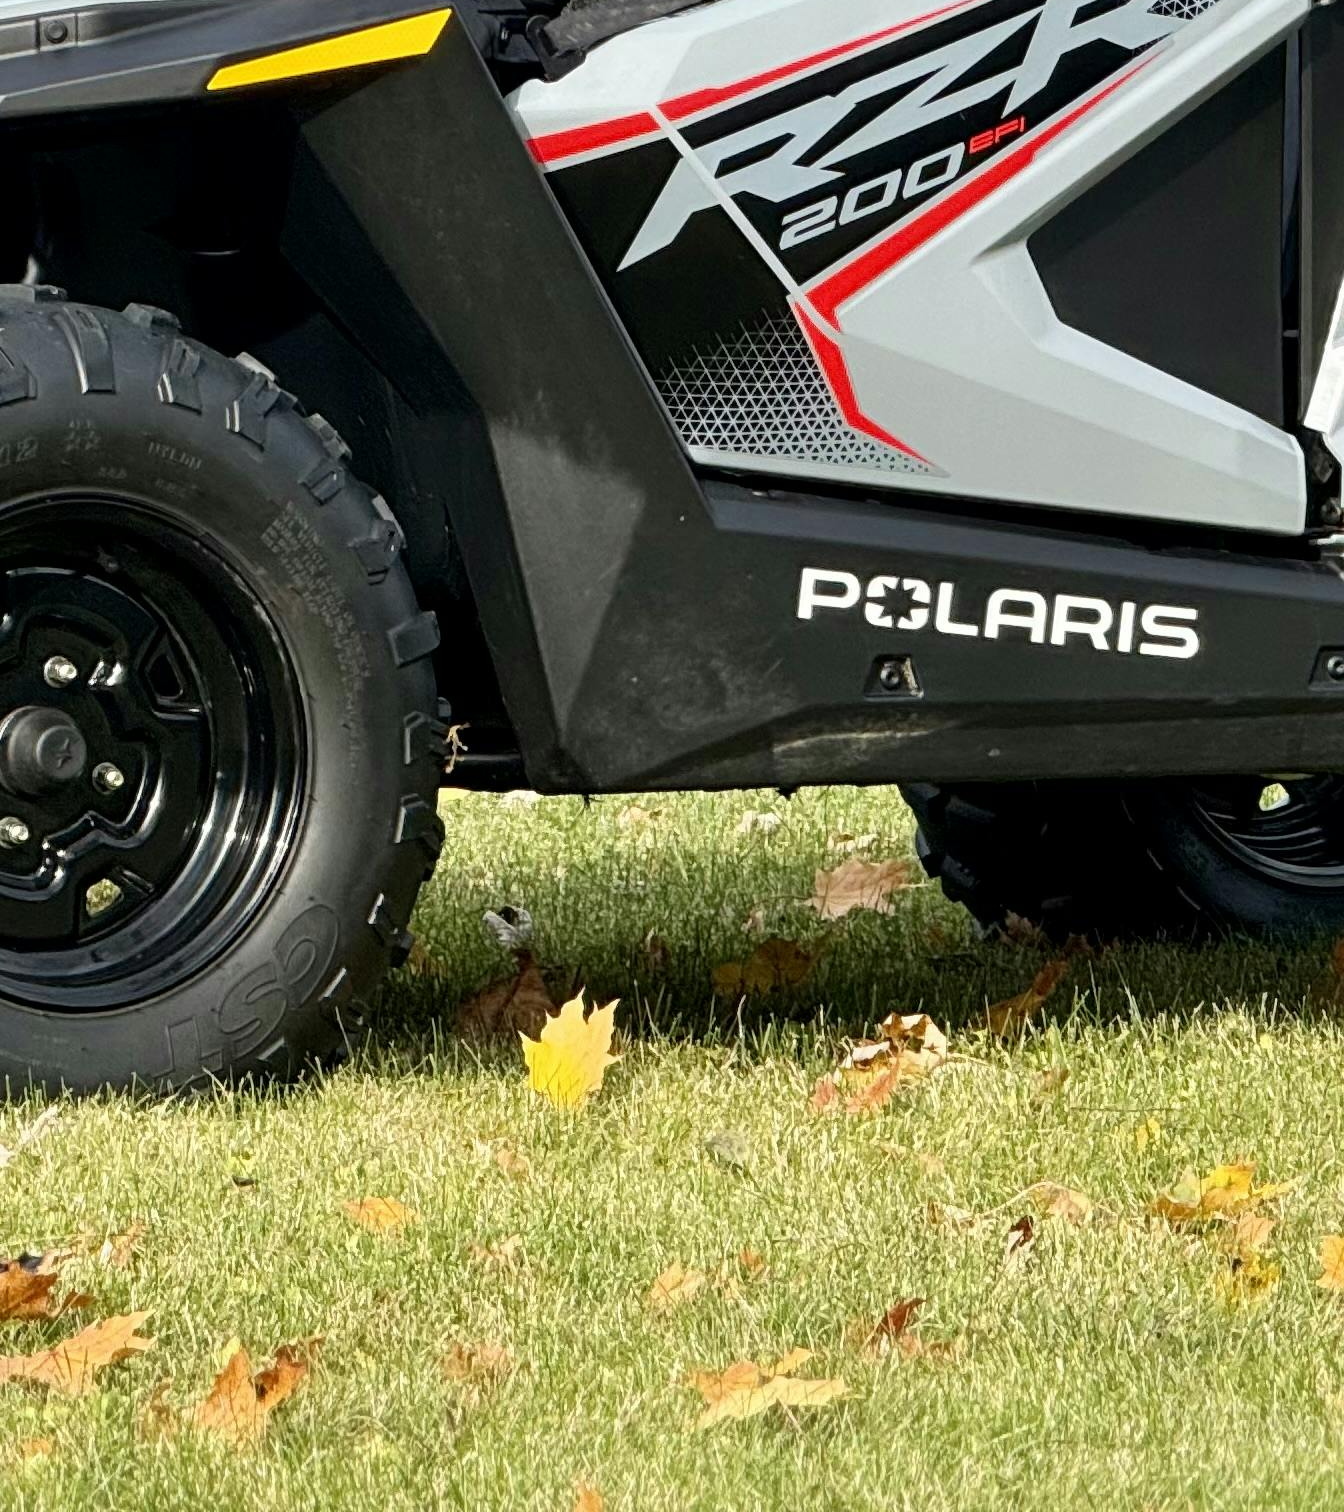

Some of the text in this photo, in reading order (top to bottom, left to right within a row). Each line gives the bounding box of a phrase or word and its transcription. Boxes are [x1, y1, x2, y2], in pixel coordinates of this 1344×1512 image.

[779, 116, 1025, 251] 200 EFI
[797, 567, 1201, 659] POLARIS
[151, 903, 341, 1091] CST
